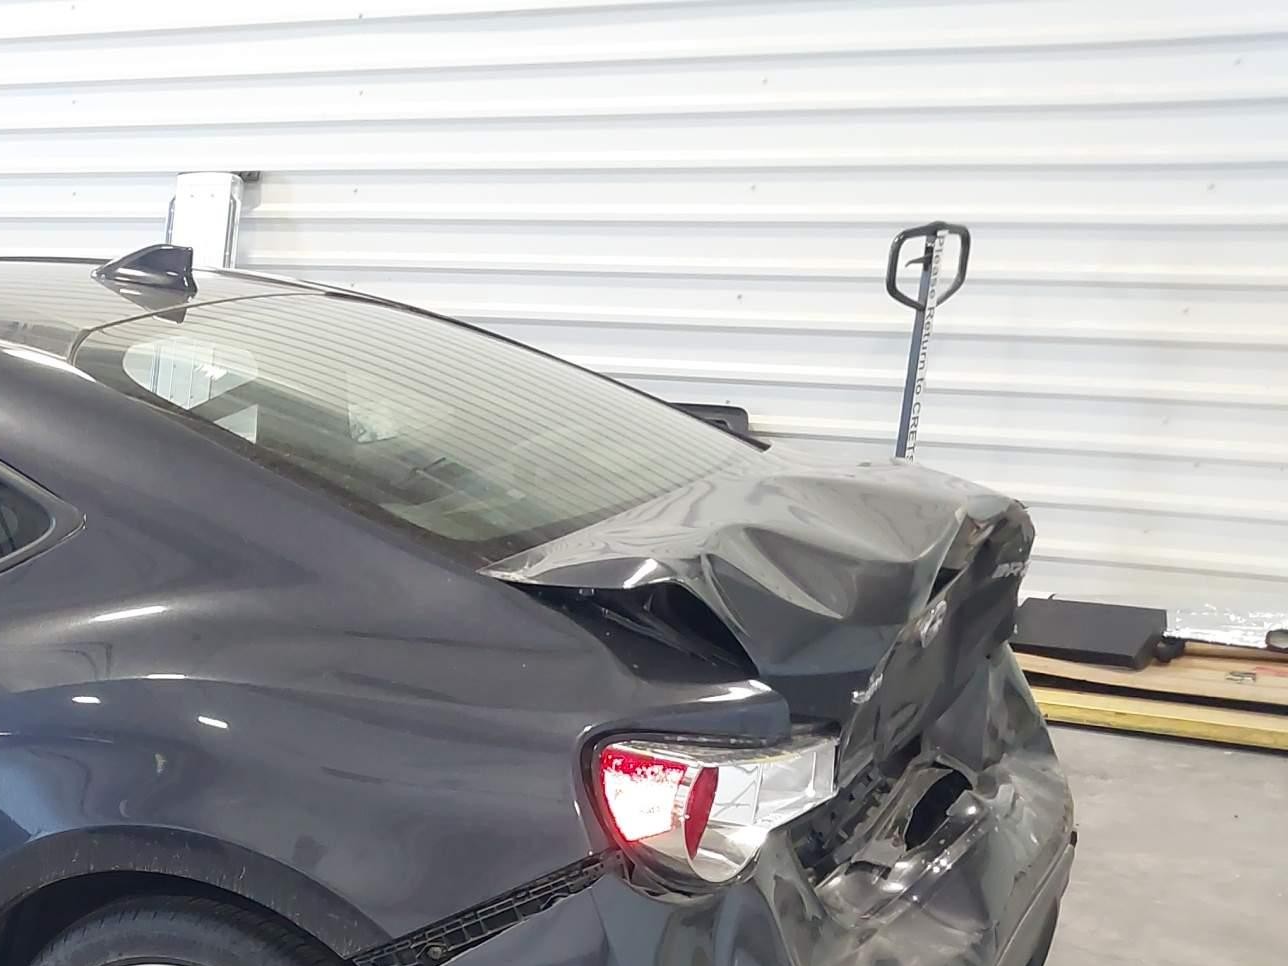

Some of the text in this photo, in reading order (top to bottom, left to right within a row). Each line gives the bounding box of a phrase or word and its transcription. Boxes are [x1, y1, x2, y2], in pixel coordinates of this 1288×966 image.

[929, 235, 946, 300] Please
[918, 307, 935, 371] Return
[915, 377, 924, 395] to
